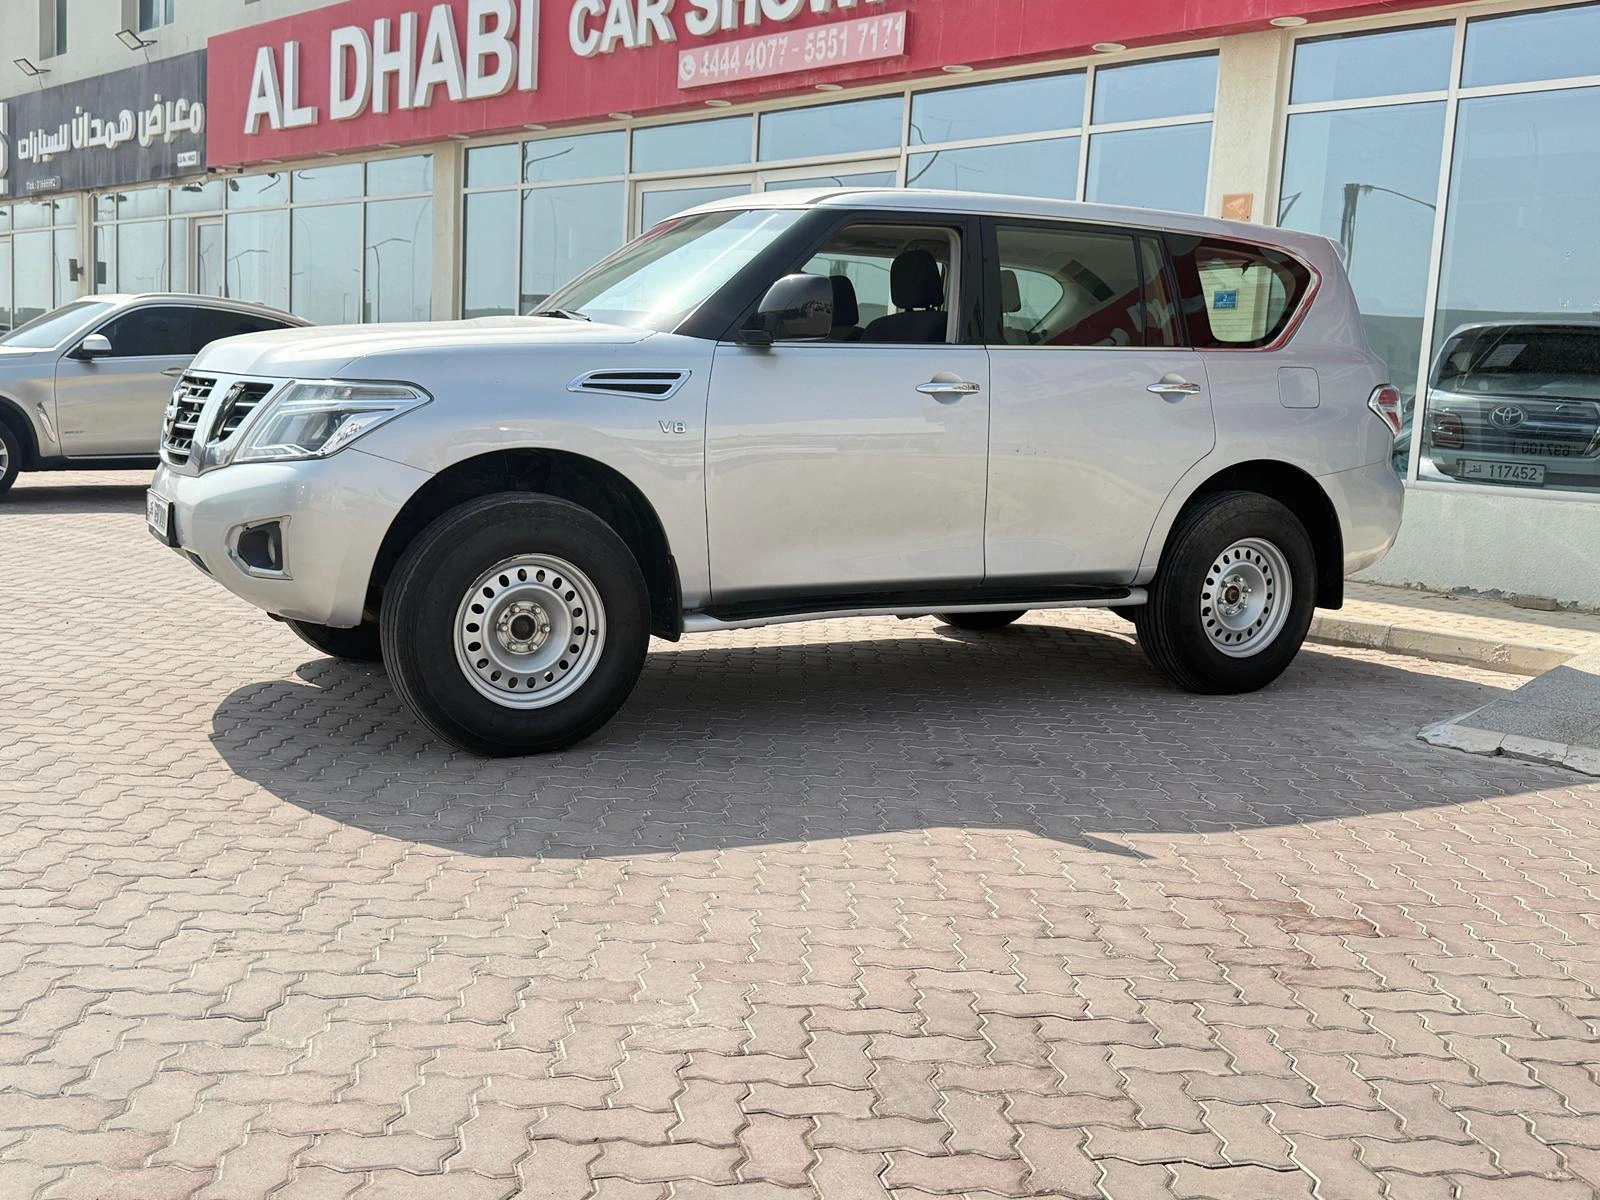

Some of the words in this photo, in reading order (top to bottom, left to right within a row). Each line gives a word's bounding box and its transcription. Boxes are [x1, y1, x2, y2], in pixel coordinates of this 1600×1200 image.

[569, 0, 677, 57] CAR
[804, 24, 848, 64] 5551
[244, 40, 318, 135] AL
[330, 0, 540, 120] DHABI
[71, 105, 136, 149] همدان
[138, 93, 205, 148] معرض
[17, 123, 71, 163] للسيارات
[658, 419, 687, 434] V8
[1489, 462, 1538, 481] 117452
